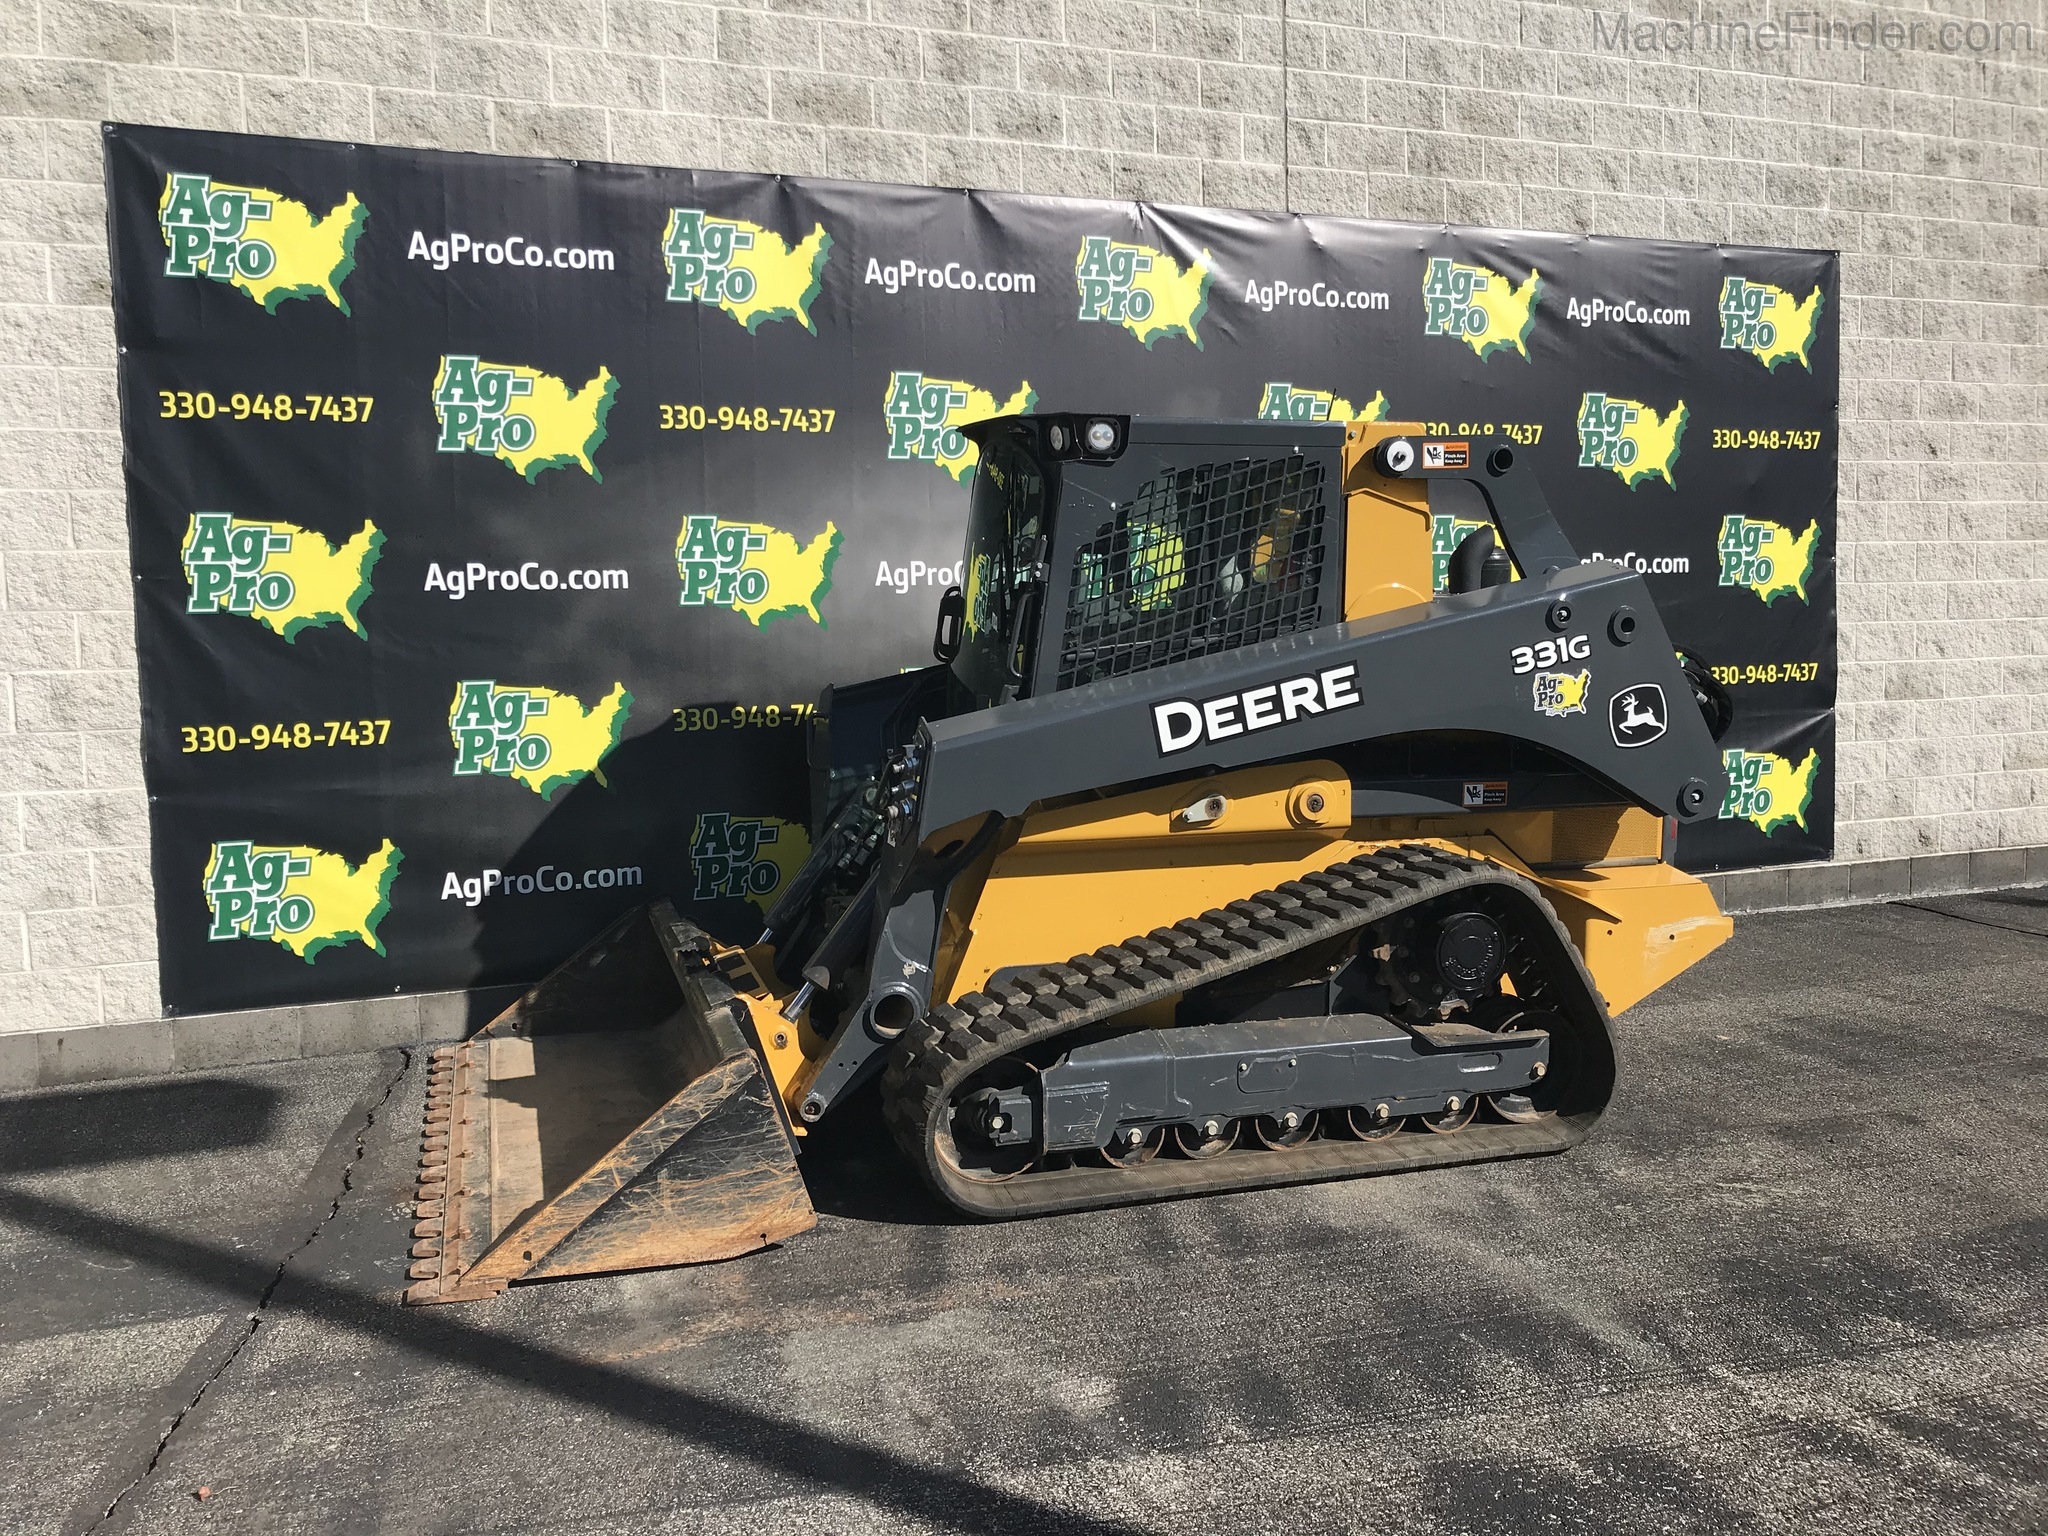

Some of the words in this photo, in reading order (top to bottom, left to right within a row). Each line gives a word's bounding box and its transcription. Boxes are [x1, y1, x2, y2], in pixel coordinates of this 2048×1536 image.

[163, 173, 272, 236] Ag-
[164, 225, 276, 278] Pro
[407, 232, 616, 271] AgProCo.com
[666, 209, 755, 266] Ag-
[666, 256, 756, 302] Pro
[865, 257, 1036, 294] AgProCo.com
[1078, 236, 1151, 288] Ag-
[1425, 257, 1488, 305] Ag-
[1078, 279, 1154, 321] Pro
[1245, 279, 1389, 311] AgProCo.com
[1567, 298, 1690, 327] AgProCo.com
[1721, 277, 1776, 319] Ag-
[1425, 297, 1489, 337] Pro
[1720, 313, 1777, 351] Pro
[437, 355, 533, 412] Ag-
[886, 371, 967, 425] Ag-
[159, 391, 374, 423] 330-948-7437
[437, 404, 536, 452] Pro
[660, 404, 836, 434] 330-948-7437
[1579, 391, 1637, 437] Ag-
[888, 417, 968, 459] Pro
[1422, 422, 1543, 445] 30-9487437
[1578, 430, 1637, 468] Pro
[1712, 429, 1821, 450] 330-948-7437
[188, 512, 292, 572] Ag-
[678, 515, 768, 570] Ag-
[1721, 515, 1774, 557] Ag-
[187, 563, 294, 614] Pro
[424, 562, 630, 600] AgProCo.com
[679, 560, 769, 606] Pro
[875, 560, 963, 594] AgProC
[1719, 551, 1774, 588] Pro
[1511, 634, 1592, 675] 331G
[1711, 663, 1819, 686] 330-948-7437
[1536, 675, 1564, 694] Ag-
[1537, 691, 1565, 708] Pro
[451, 679, 549, 733] Ag-
[672, 703, 818, 732] 330-948-74
[1154, 665, 1360, 753] DEERE
[181, 719, 392, 753] 330-948-7437
[453, 727, 552, 776] Pro
[1725, 748, 1775, 790] Ag-
[1717, 783, 1773, 819] Pro
[696, 812, 778, 863] Ag-
[207, 840, 311, 897] Ag-
[441, 864, 643, 906] AgProCo.com
[694, 855, 781, 900] Pro
[208, 890, 315, 941] Pro
